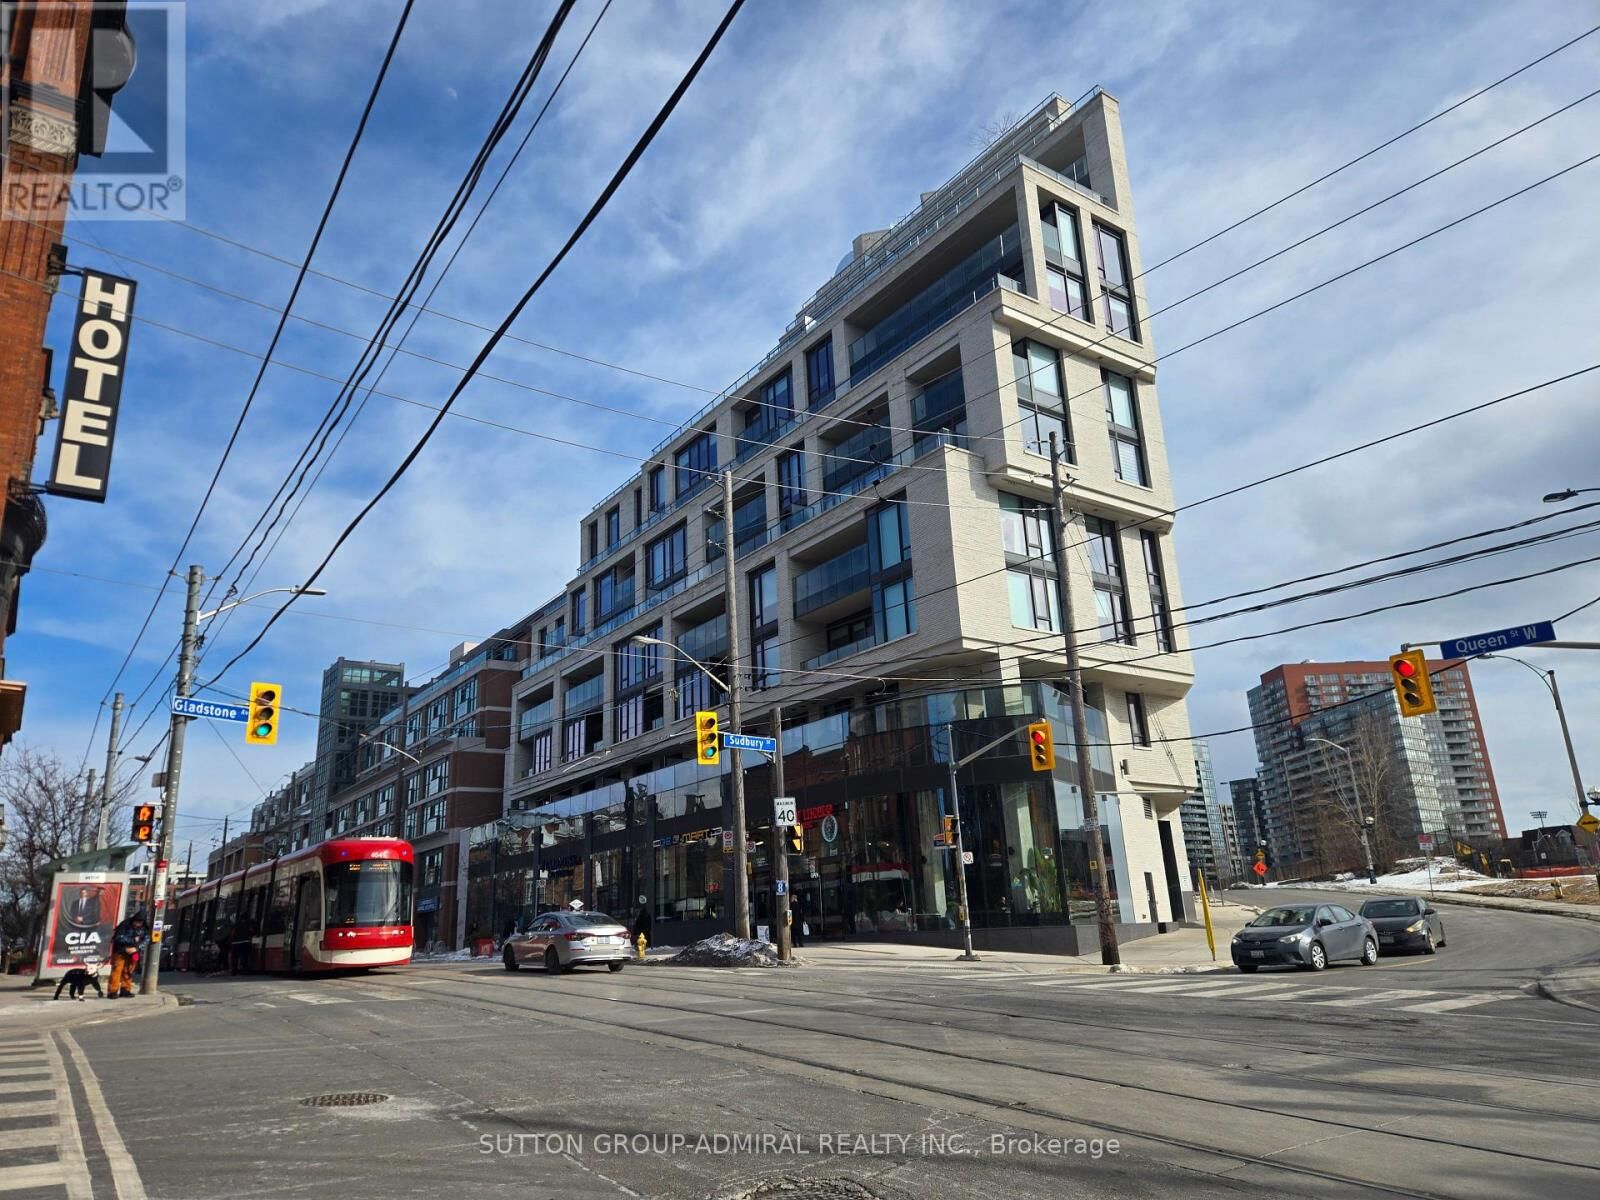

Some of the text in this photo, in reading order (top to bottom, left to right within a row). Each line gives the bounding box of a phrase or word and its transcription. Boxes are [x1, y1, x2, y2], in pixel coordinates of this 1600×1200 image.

[55, 275, 130, 491] HOTEL
[1455, 625, 1537, 653] Queen St W
[174, 699, 237, 719] Gladstone
[730, 735, 764, 750] Sudbury
[778, 809, 795, 822] 40
[64, 931, 102, 945] CIA
